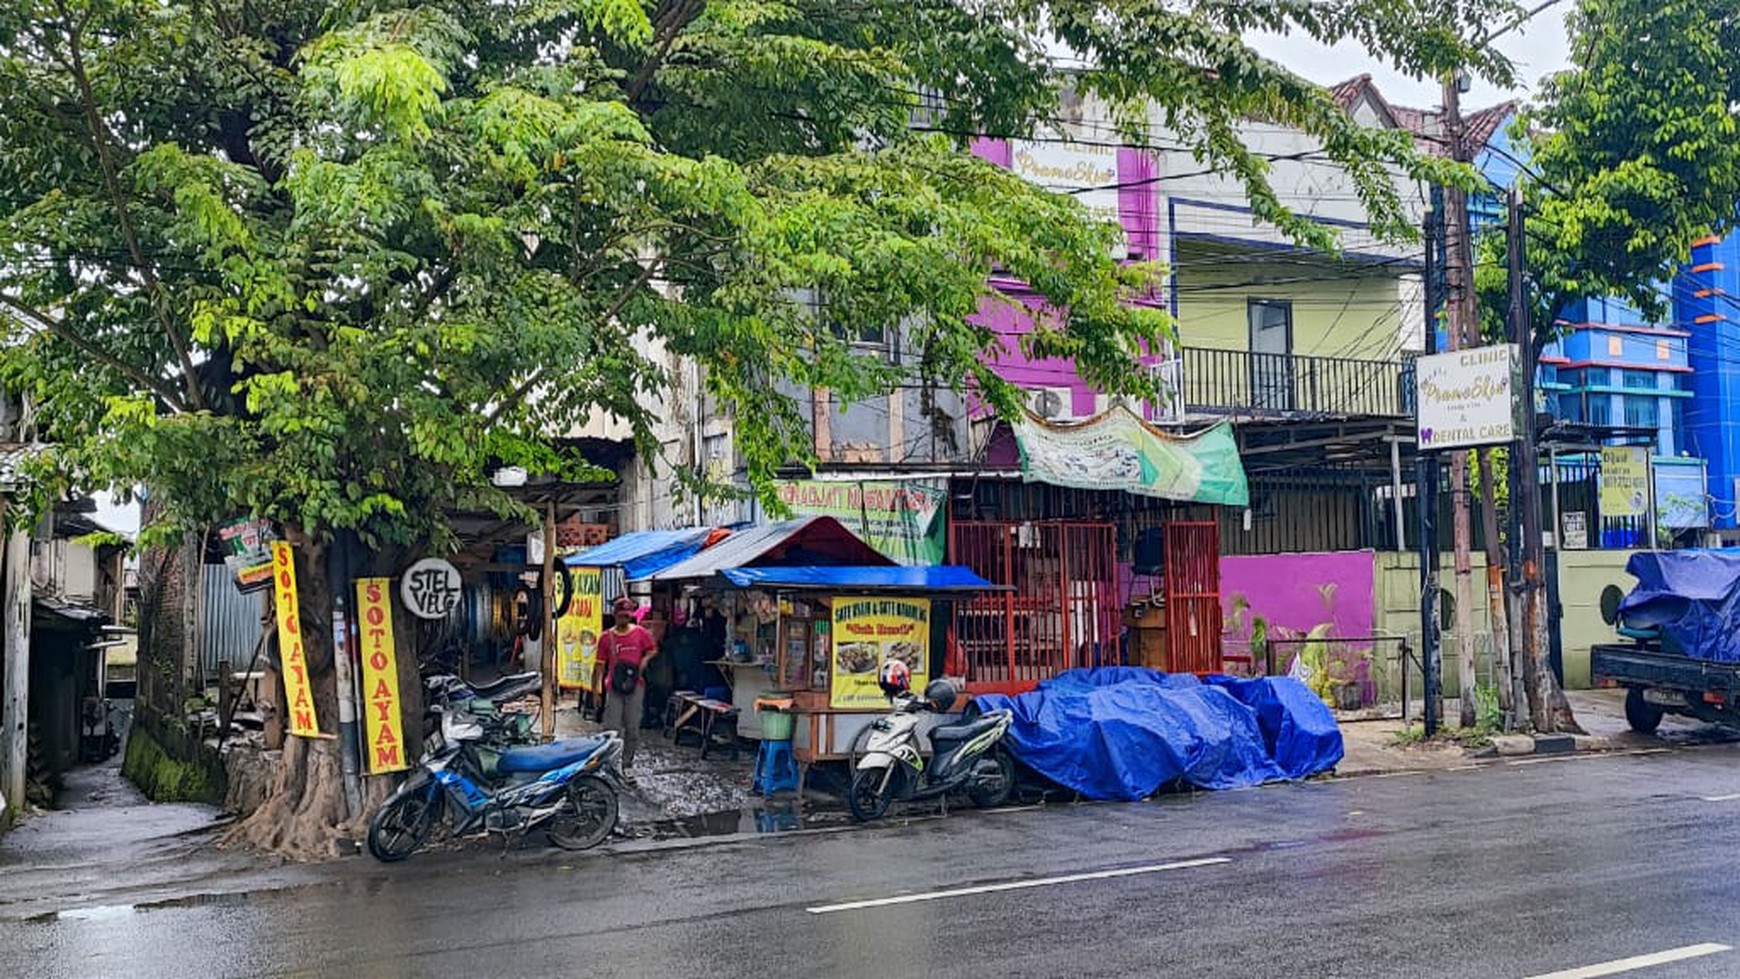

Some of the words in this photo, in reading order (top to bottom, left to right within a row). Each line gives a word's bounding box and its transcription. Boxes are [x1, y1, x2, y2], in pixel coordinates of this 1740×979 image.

[1433, 426, 1476, 443] DENTAL
[1479, 423, 1510, 439] CARE
[408, 569, 459, 593] STEL
[278, 546, 298, 634] SOTO
[290, 642, 313, 731] AYAM
[366, 584, 388, 672] SOTO
[372, 679, 399, 768] AYAM
